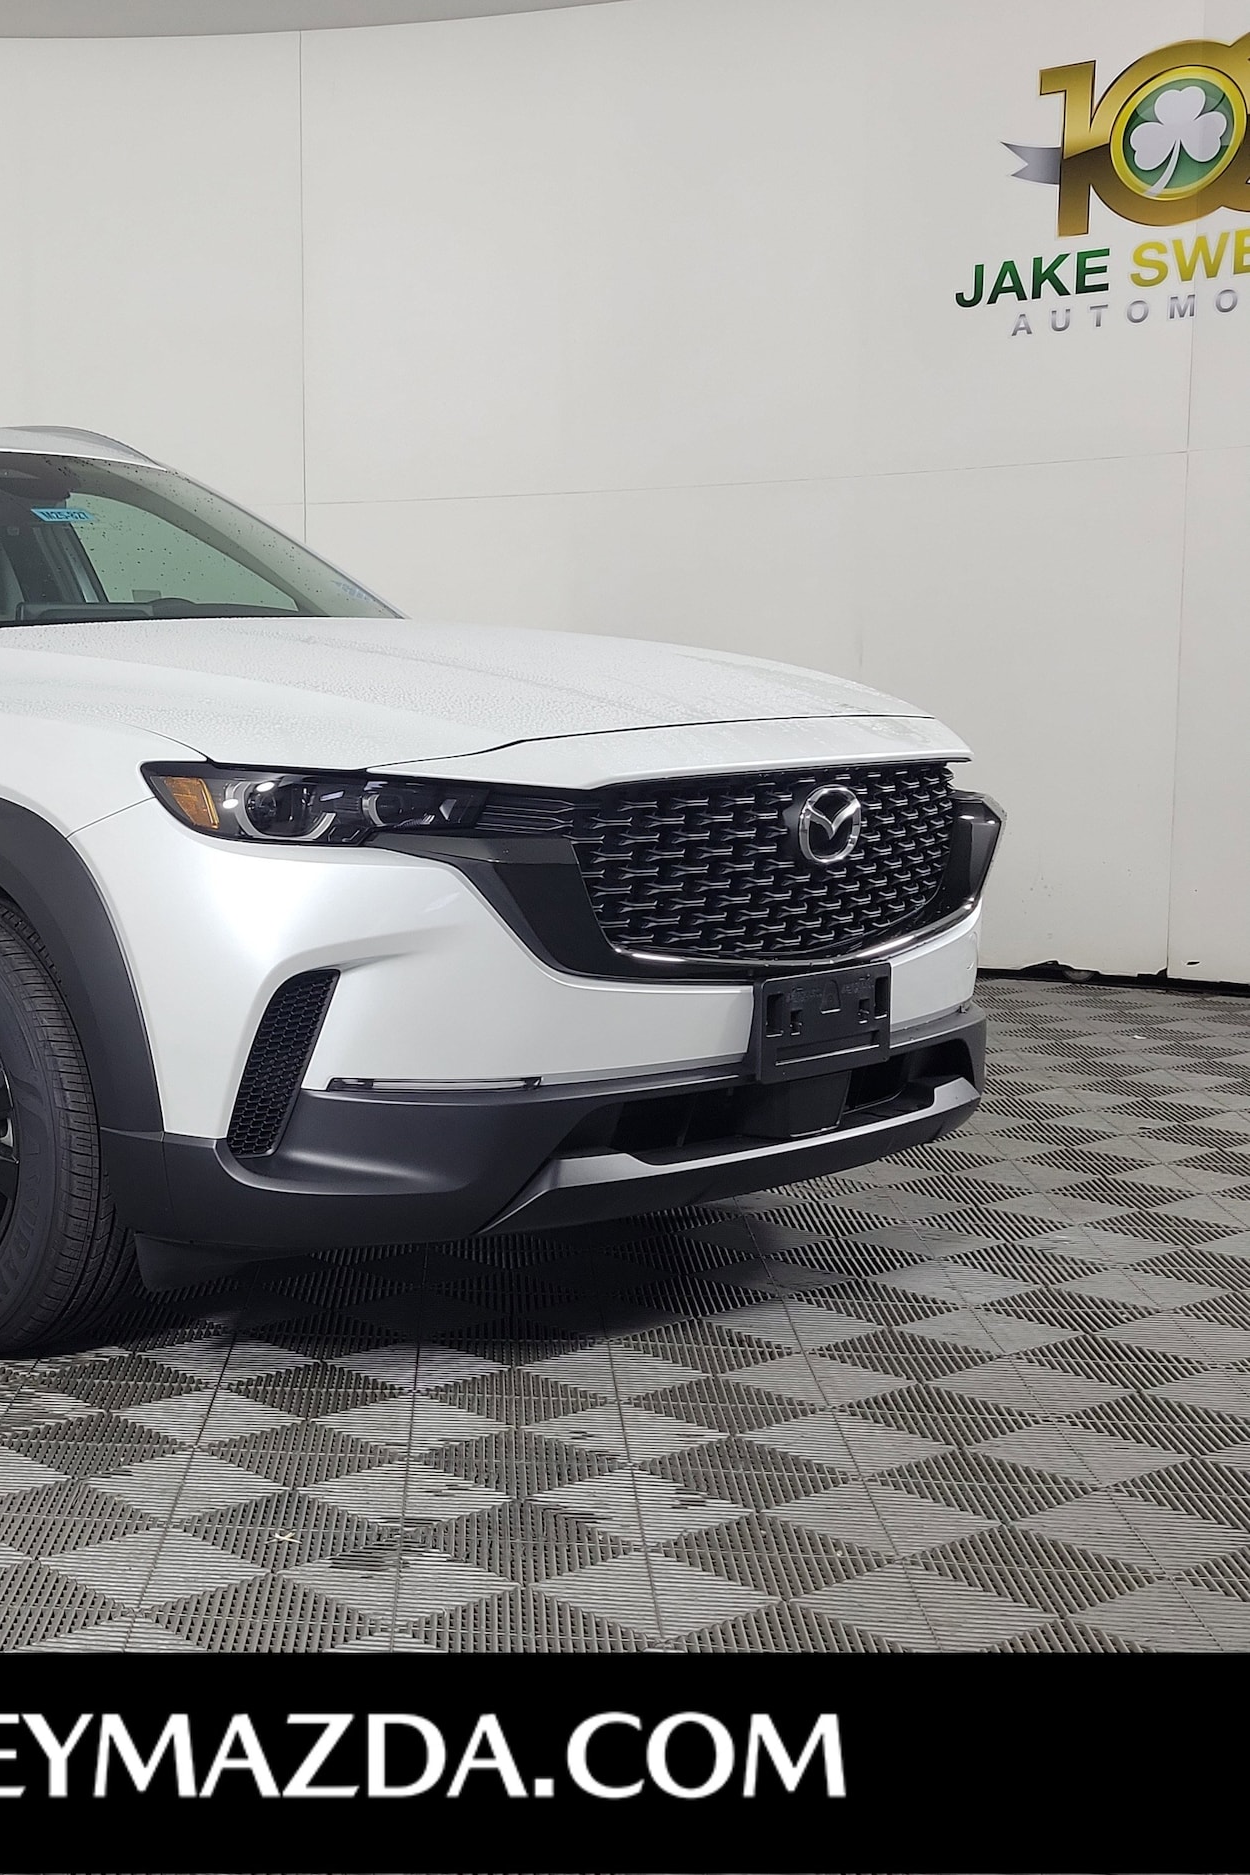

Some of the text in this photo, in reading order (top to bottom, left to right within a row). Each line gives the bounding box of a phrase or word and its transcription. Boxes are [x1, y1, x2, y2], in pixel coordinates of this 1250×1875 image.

[1039, 32, 1250, 236] 10
[955, 247, 1111, 308] JAKE
[1011, 289, 1238, 336] AUTOMO
